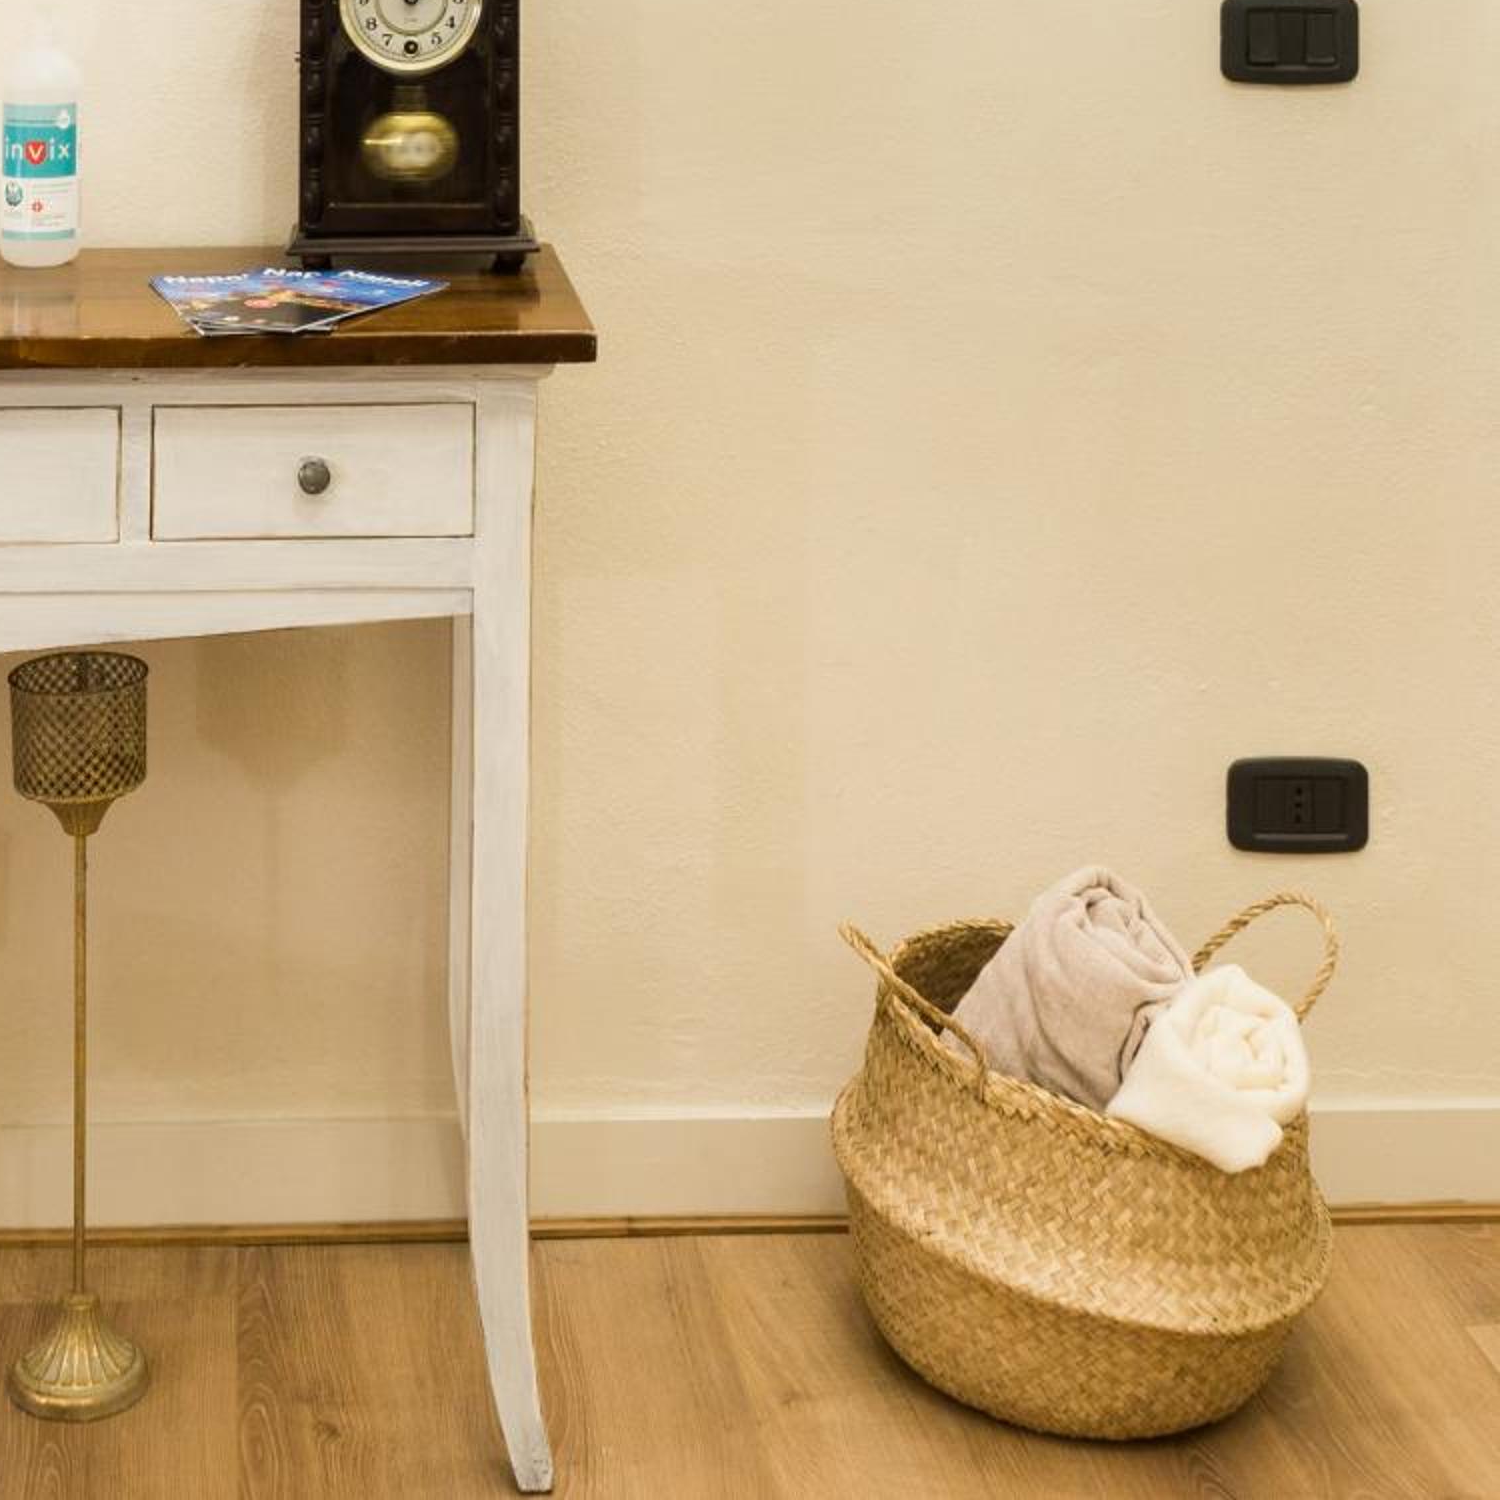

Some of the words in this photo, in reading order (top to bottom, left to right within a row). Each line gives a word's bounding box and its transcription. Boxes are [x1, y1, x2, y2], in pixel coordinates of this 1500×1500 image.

[366, 17, 377, 30] 8
[445, 16, 455, 28] 4
[382, 33, 393, 46] 7
[431, 33, 442, 45] 5
[5, 135, 70, 161] invix
